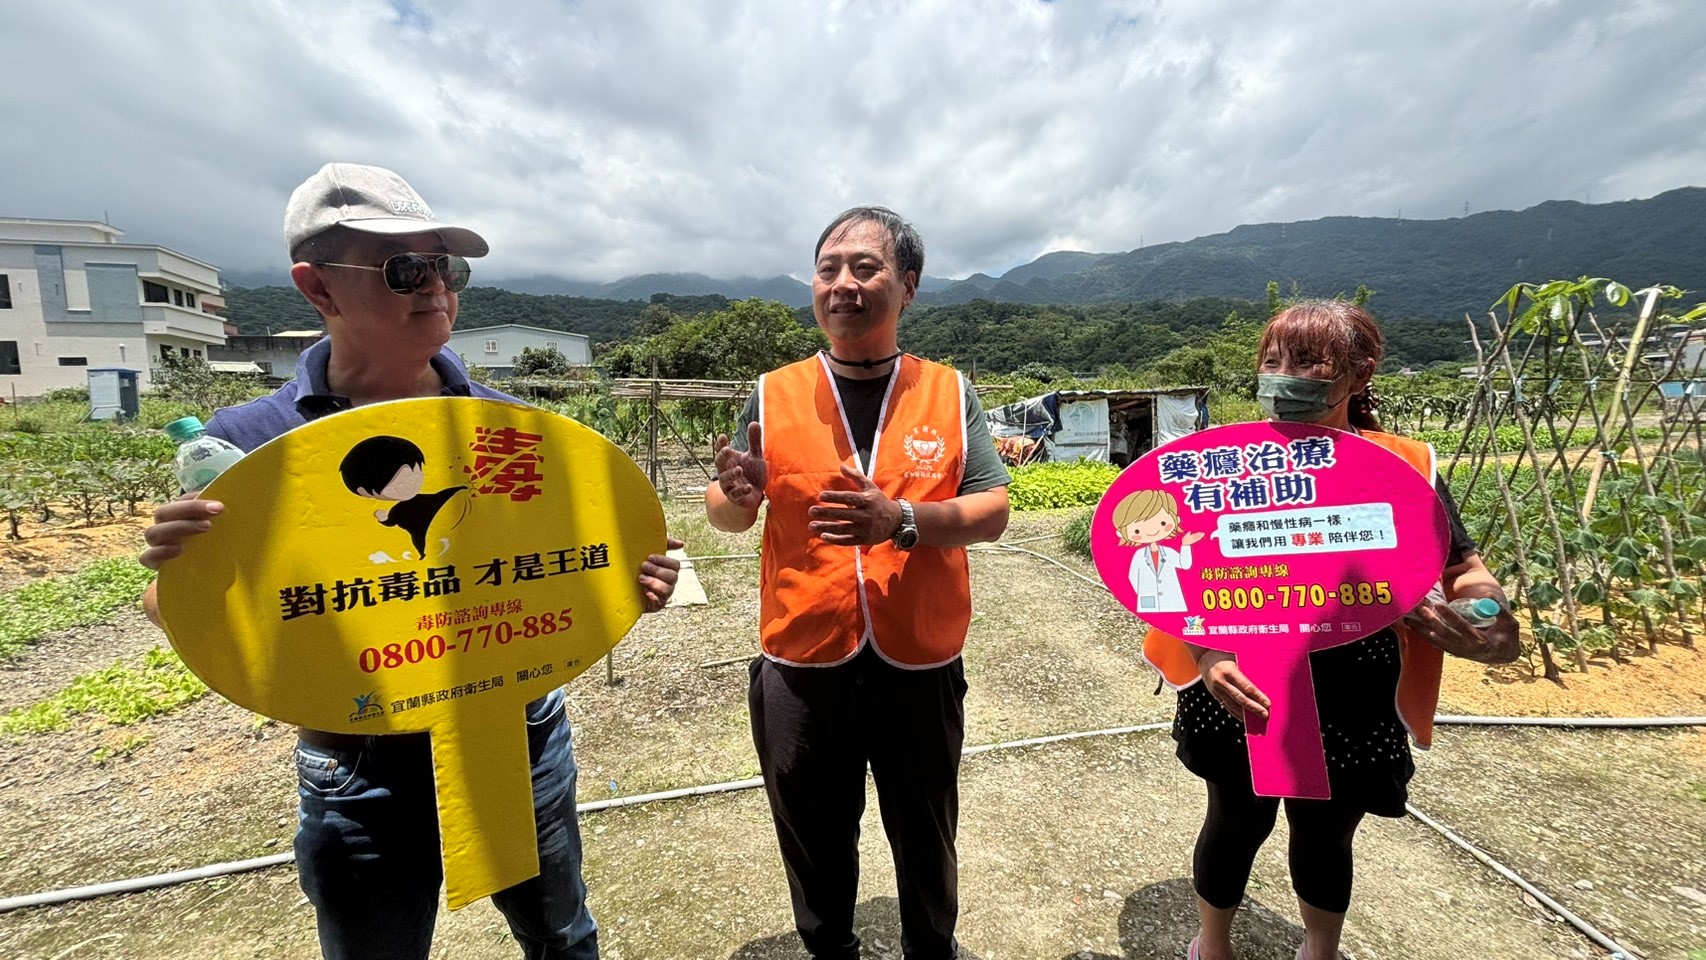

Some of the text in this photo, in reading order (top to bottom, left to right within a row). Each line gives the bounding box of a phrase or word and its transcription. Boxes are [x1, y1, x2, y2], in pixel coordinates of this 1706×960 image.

[1159, 437, 1334, 482] 藥癮治療
[1185, 473, 1314, 512] 有補助
[1231, 535, 1288, 550] 讓我們用
[1290, 531, 1325, 547] 專業
[279, 543, 611, 621] 對抗毒品 才是王道
[1201, 563, 1290, 581] 毒防諮詢專線
[1201, 580, 1394, 611] 0800-770-885
[416, 599, 523, 632] 毒防諮詢專線
[1208, 624, 1290, 635] 宜蘭縣政府衛生局
[358, 607, 574, 674] 0800-770-885
[390, 675, 504, 714] 宜蘭縣政府衛生局
[516, 663, 554, 683] 關心您
